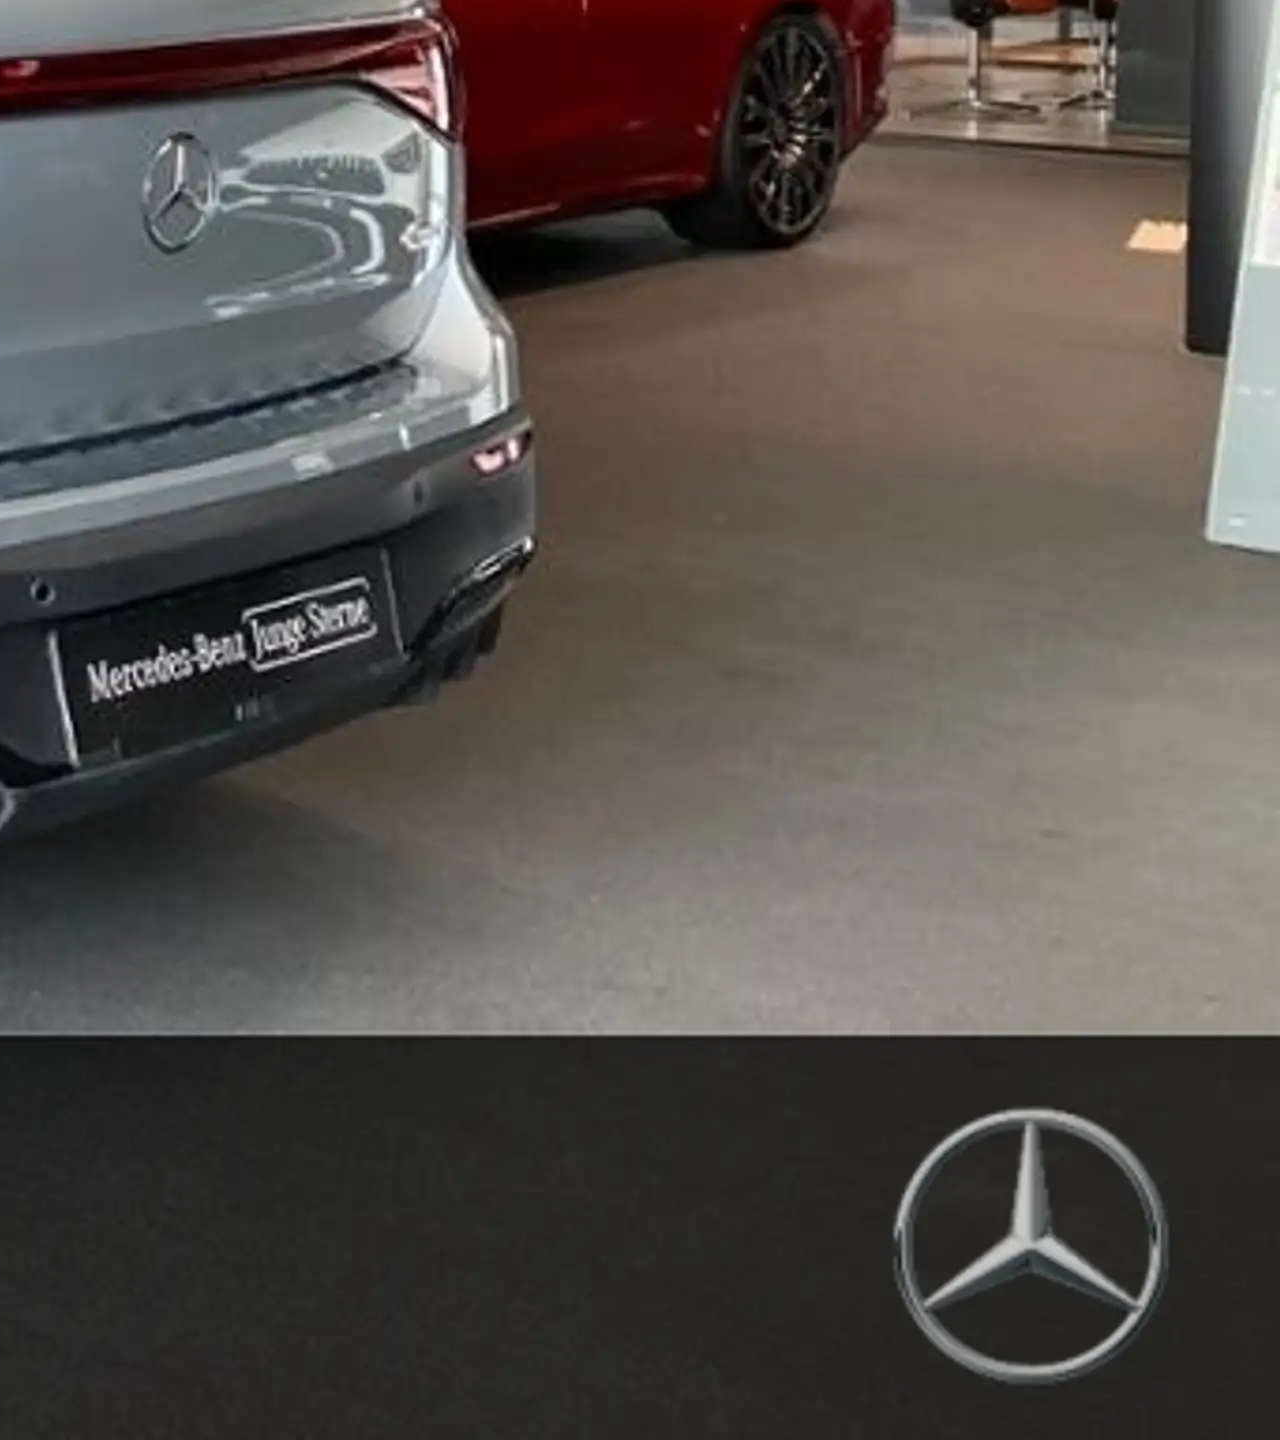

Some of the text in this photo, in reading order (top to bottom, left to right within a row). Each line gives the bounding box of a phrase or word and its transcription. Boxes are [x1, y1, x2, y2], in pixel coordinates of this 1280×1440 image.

[86, 596, 370, 703] Mercedes-Benz Junge Sterne
